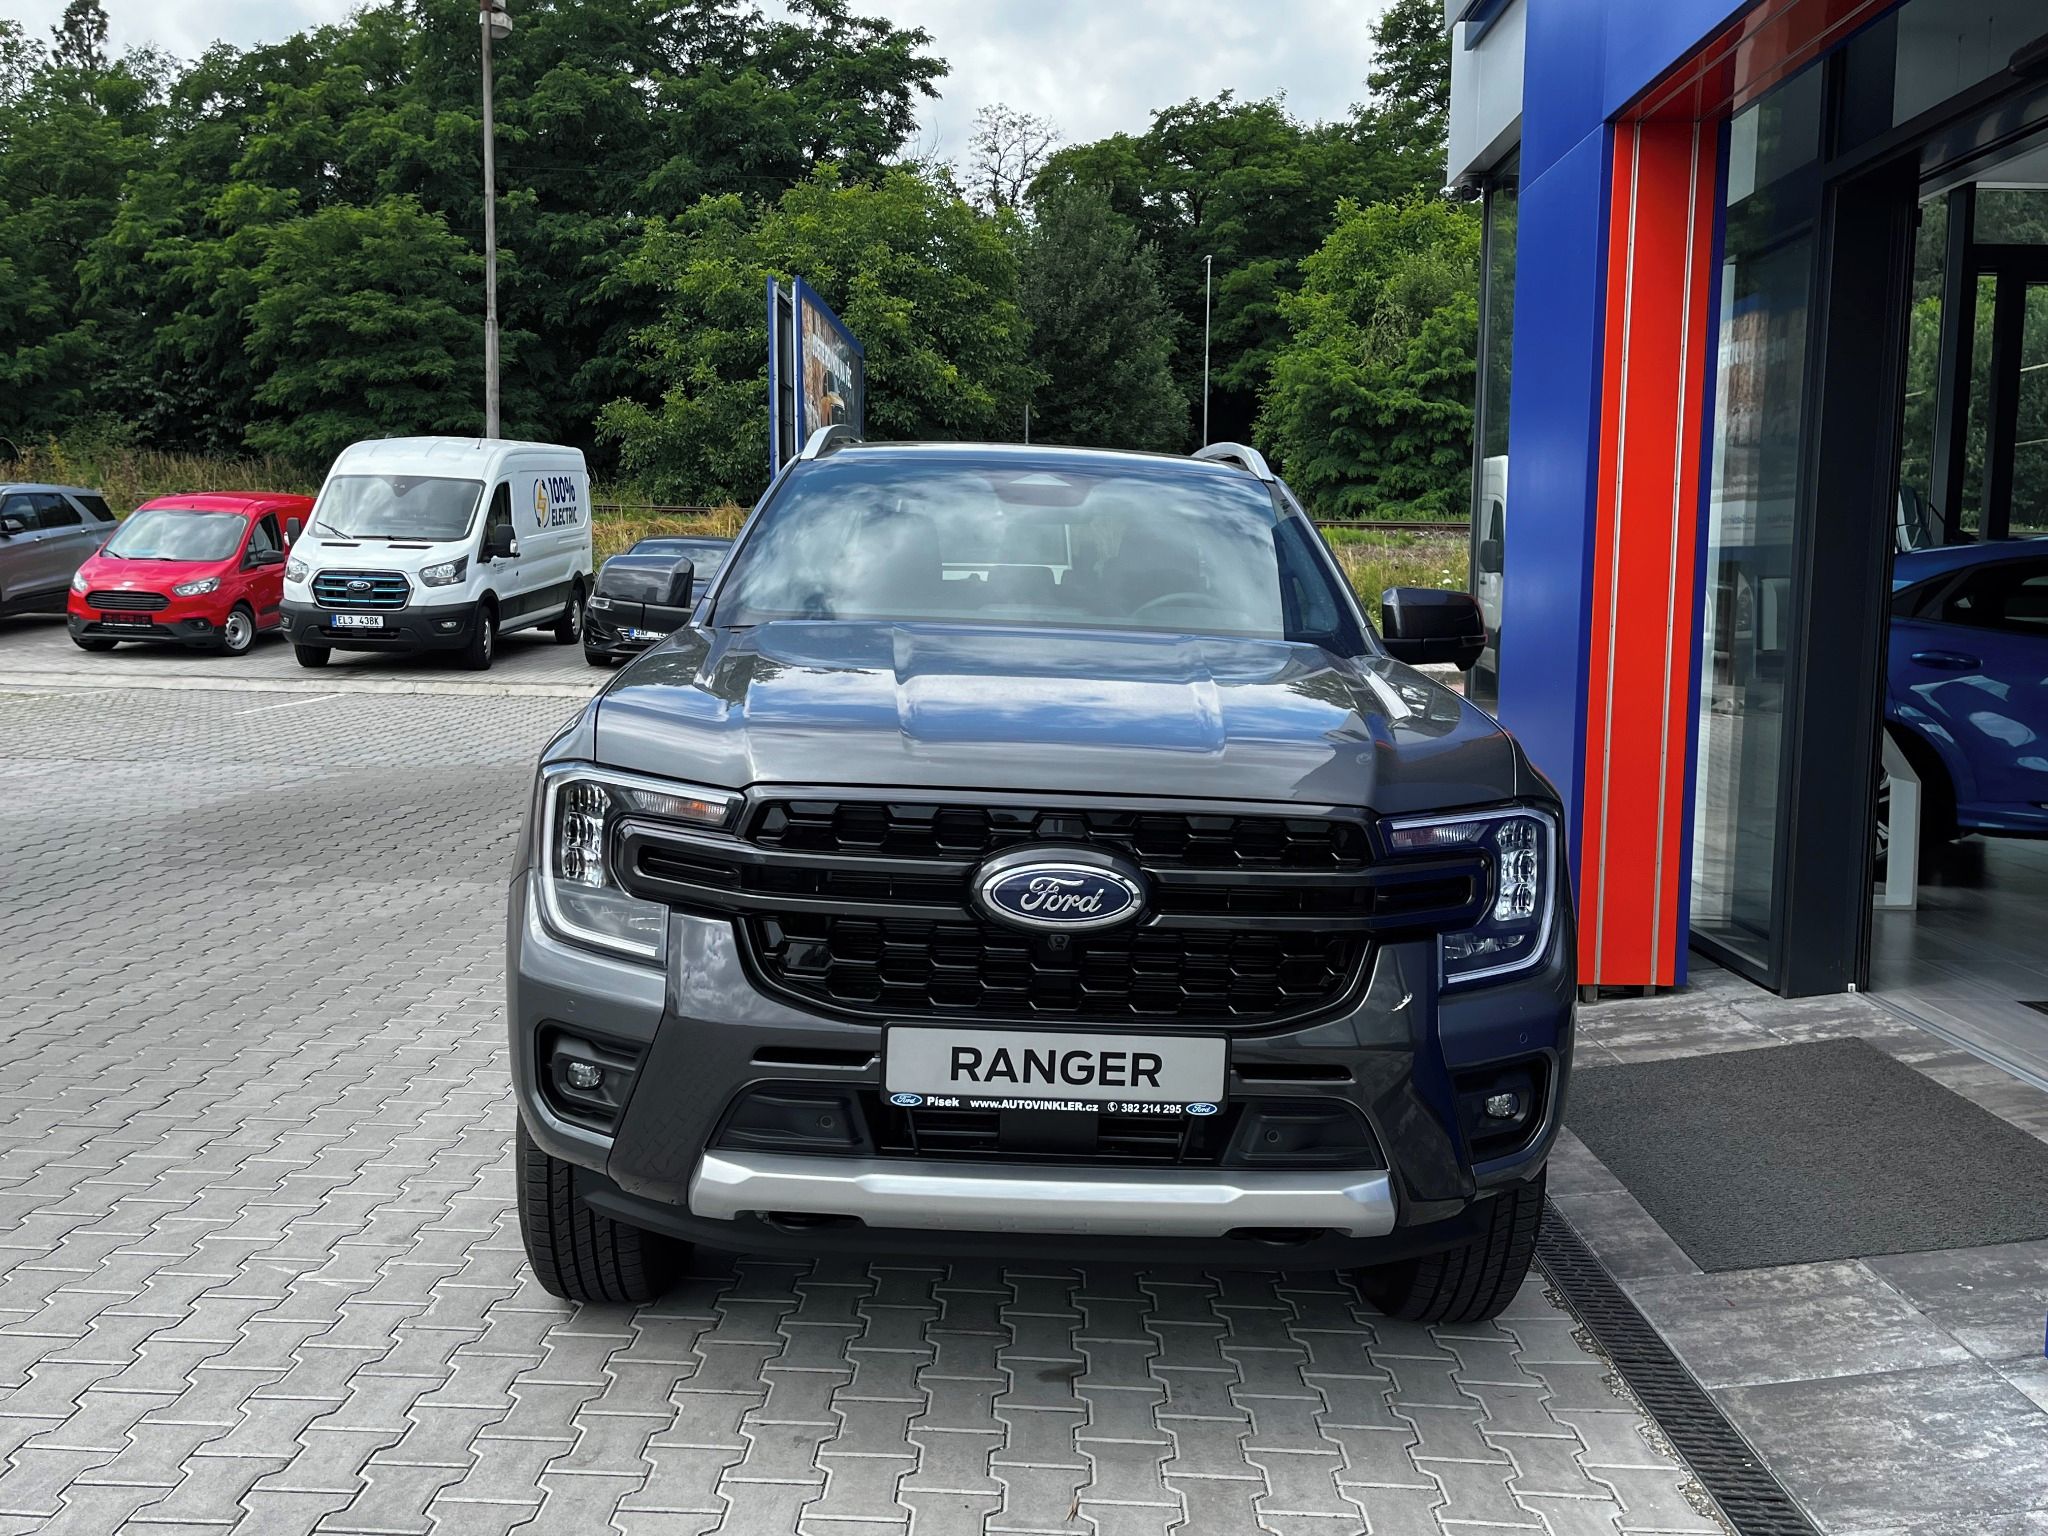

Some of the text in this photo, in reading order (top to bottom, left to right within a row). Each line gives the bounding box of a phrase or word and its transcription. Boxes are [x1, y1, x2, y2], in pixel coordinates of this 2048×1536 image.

[548, 476, 576, 504] 100%
[551, 506, 578, 526] ELECTRIC
[337, 616, 380, 626] EL3 43BK
[1020, 876, 1105, 913] Ford
[950, 1046, 1163, 1088] RANGER
[926, 1096, 960, 1107] Písek
[969, 1099, 1099, 1112] www.AUTOVINKLER.cz
[1121, 1103, 1140, 1113] 382
[1142, 1104, 1161, 1114] 214
[1163, 1104, 1182, 1114] 295
